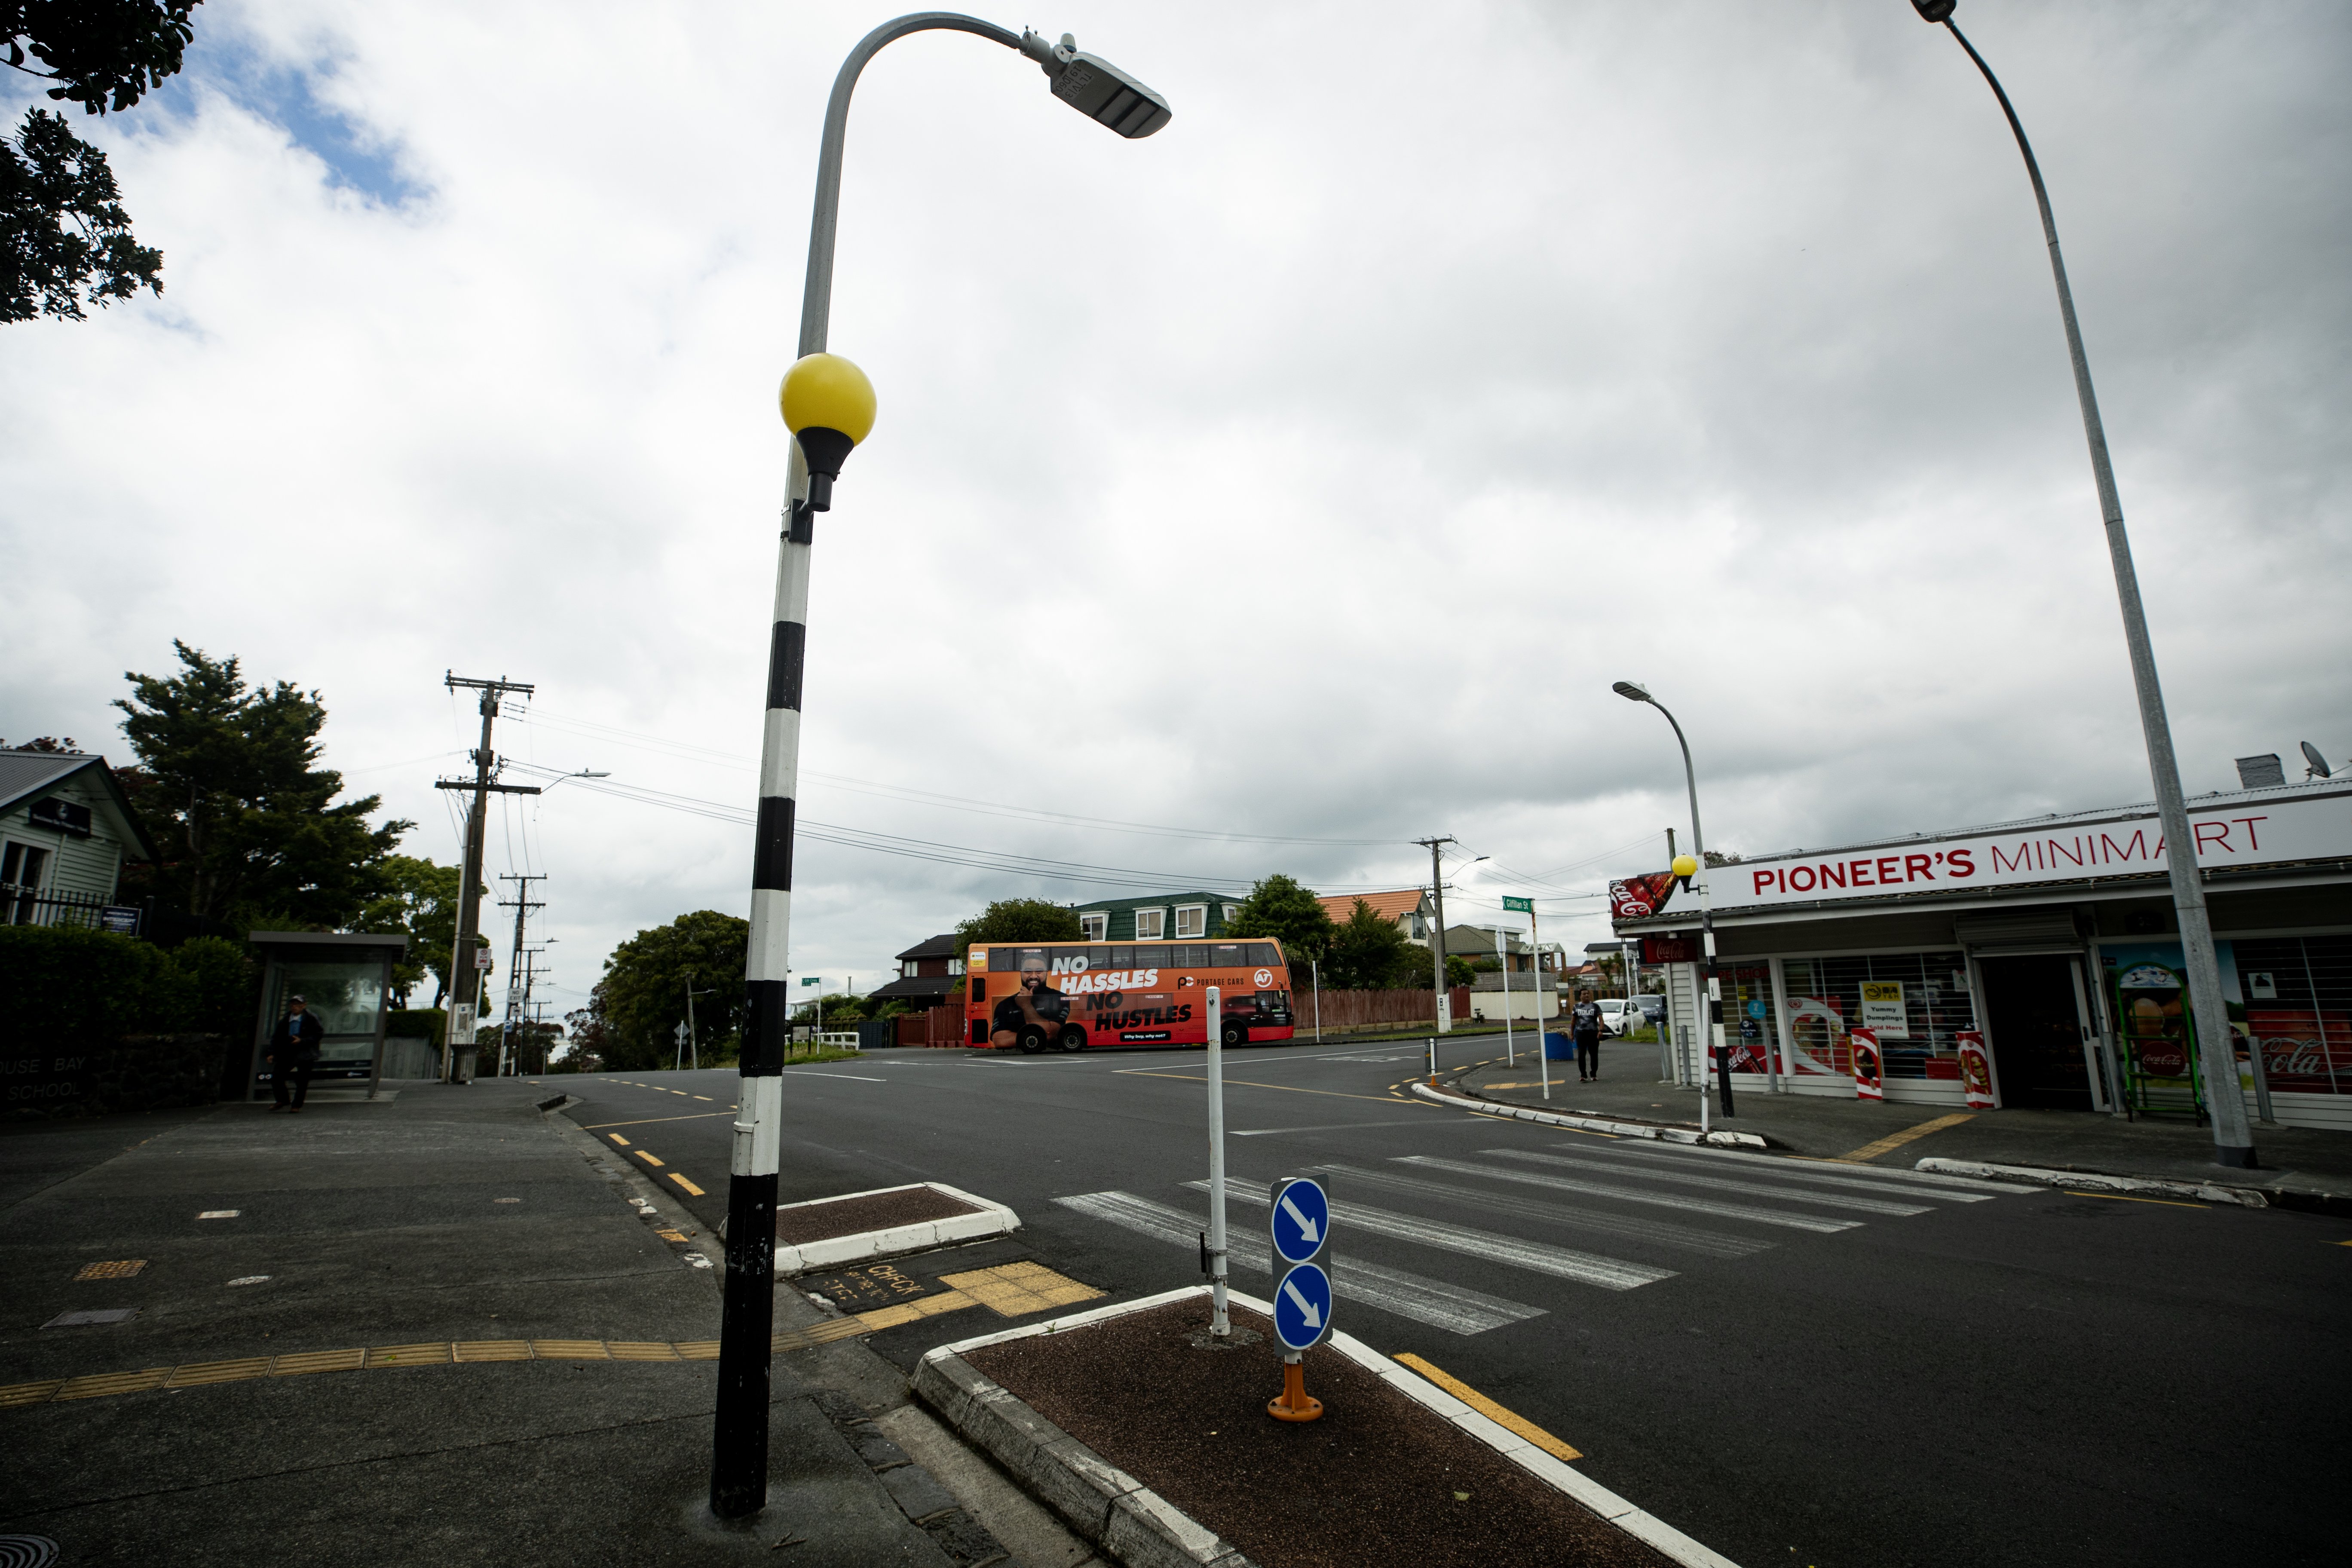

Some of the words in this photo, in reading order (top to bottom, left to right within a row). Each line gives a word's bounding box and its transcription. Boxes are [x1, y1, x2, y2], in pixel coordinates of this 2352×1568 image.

[1753, 849, 1975, 895] PIONEER'S
[1991, 817, 2268, 873] MINIMRT
[1523, 900, 1528, 910] St
[1657, 941, 1684, 959] Coca-Cola
[1051, 956, 1089, 976] NO
[1700, 970, 1733, 982] VPE
[1736, 968, 1770, 980] SHOP
[1060, 968, 1158, 995] HASSLES
[1086, 991, 1123, 1011] NO
[1095, 1004, 1192, 1032] HUSTLES
[54, 1056, 87, 1072] BAY
[2142, 1054, 2182, 1066] Coca-Cola
[7, 1081, 81, 1101] SCHOOL
